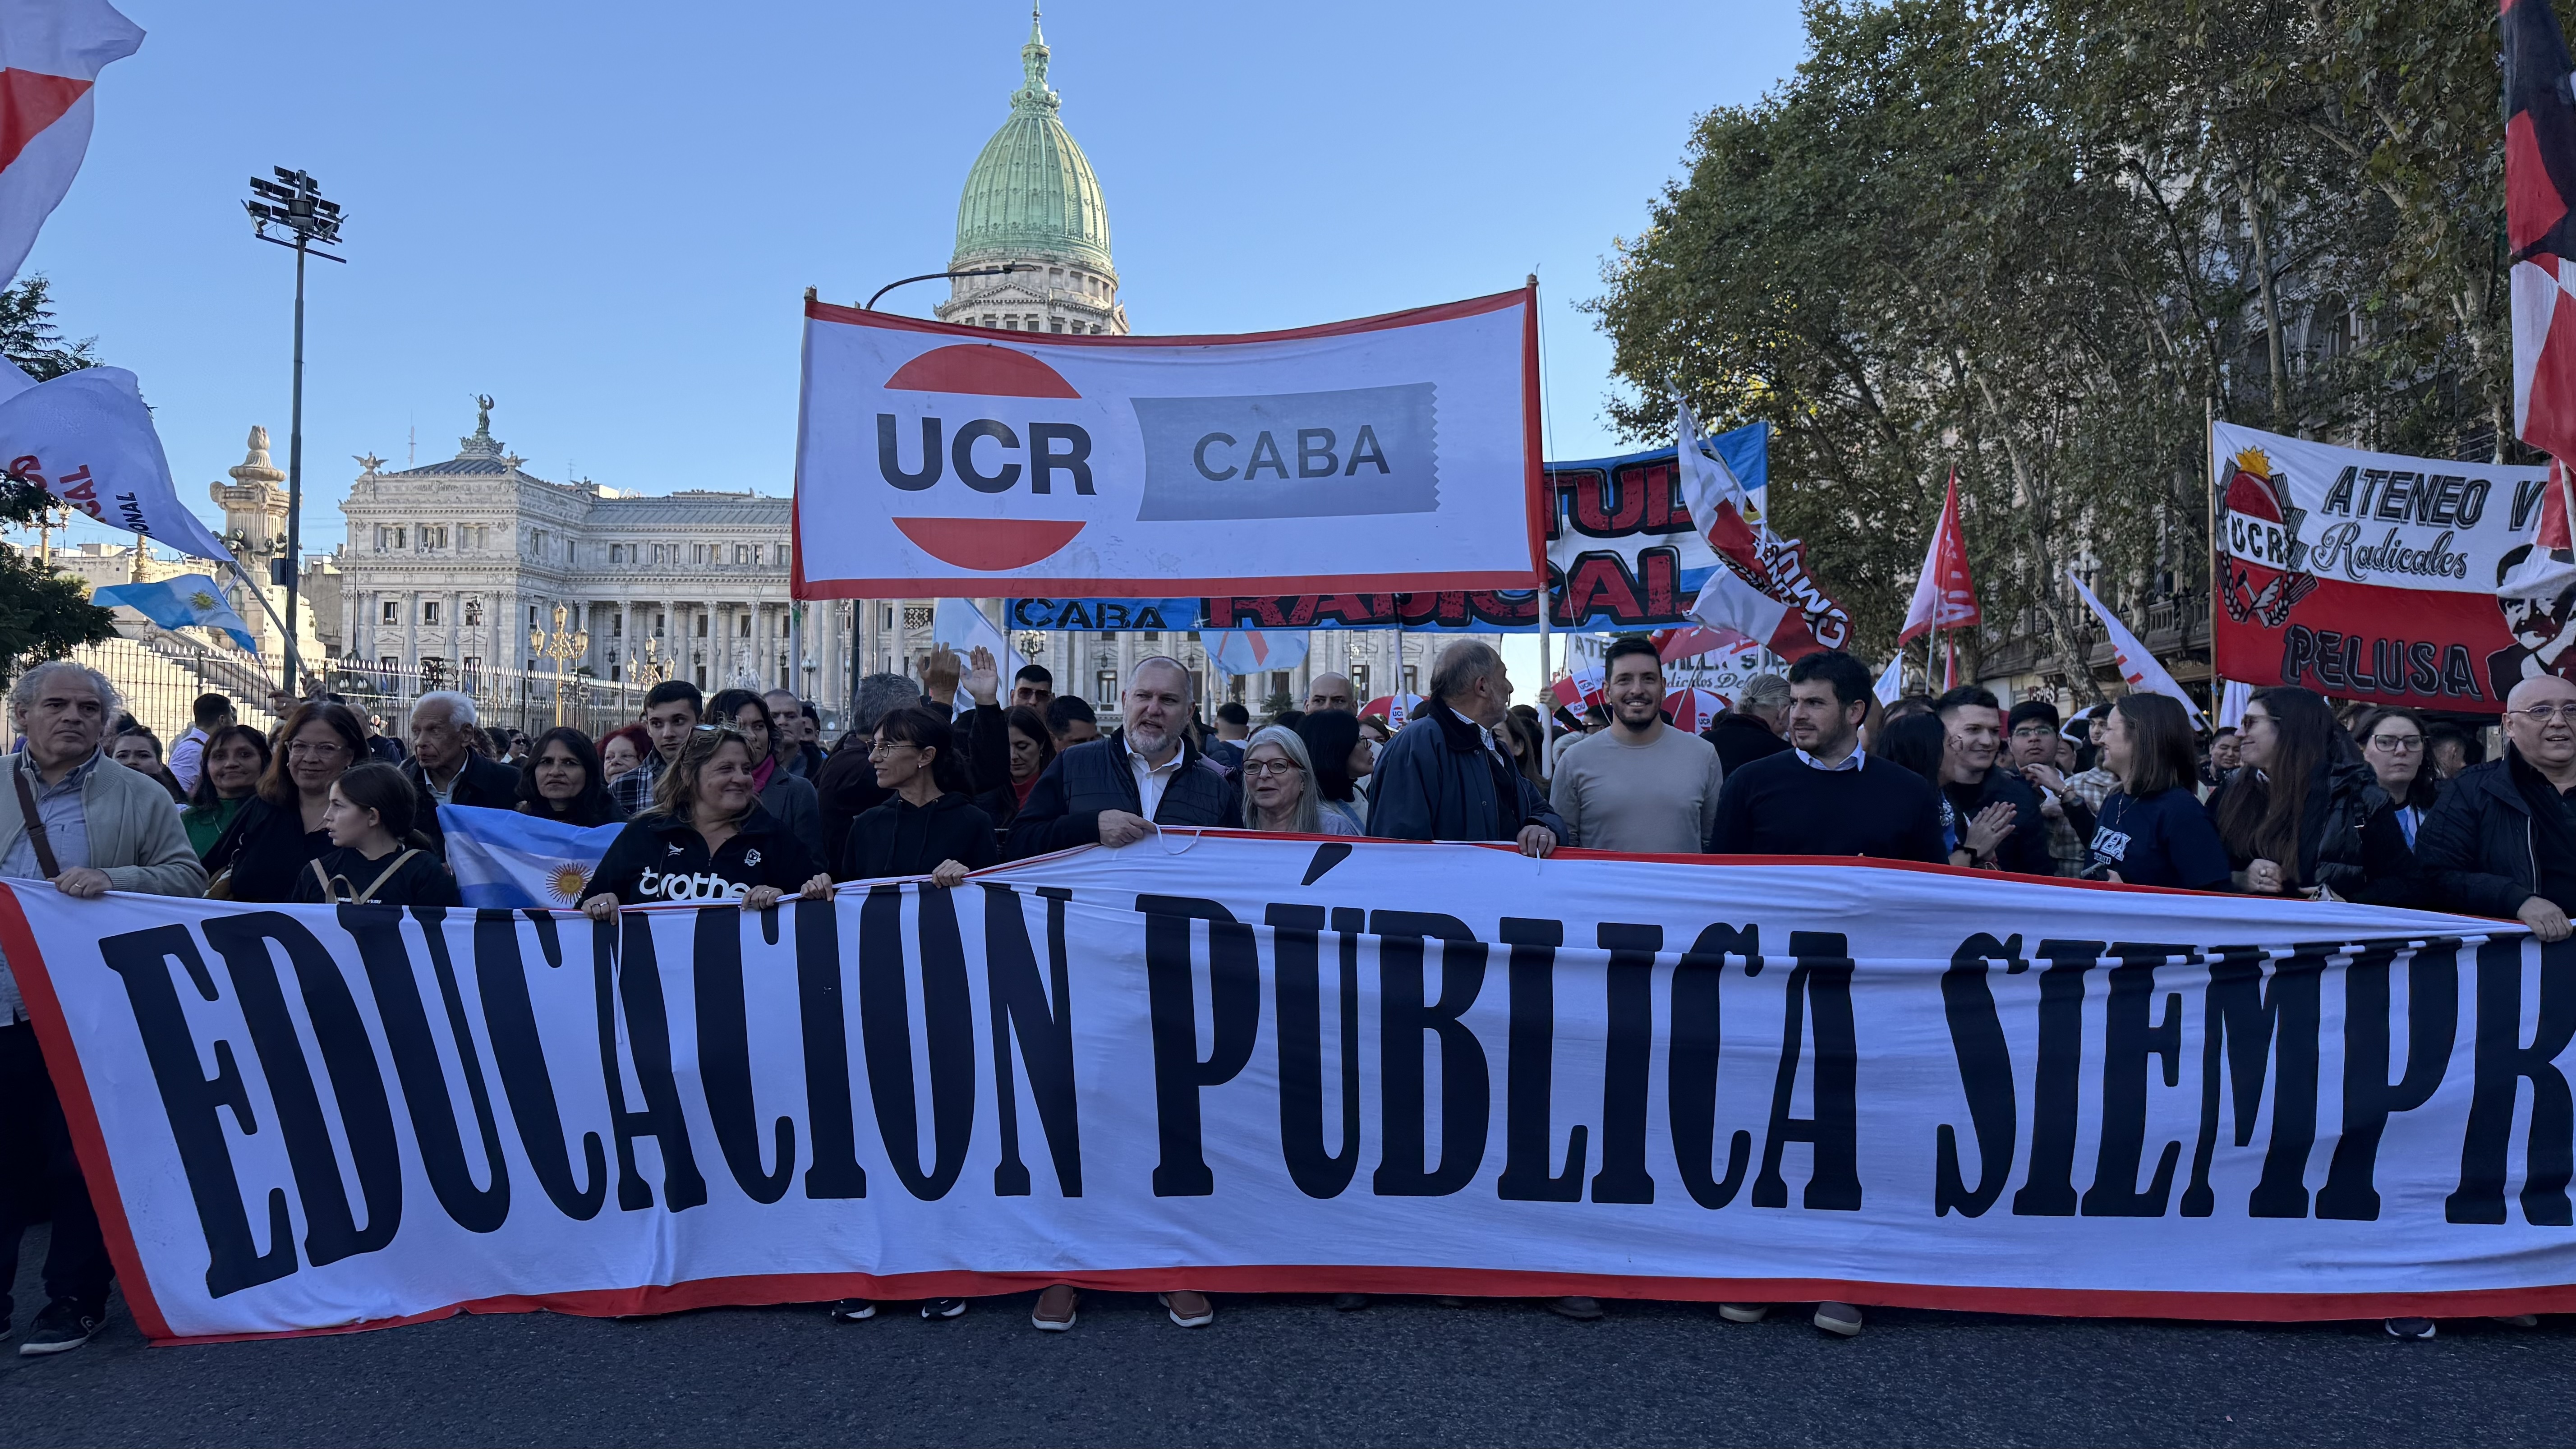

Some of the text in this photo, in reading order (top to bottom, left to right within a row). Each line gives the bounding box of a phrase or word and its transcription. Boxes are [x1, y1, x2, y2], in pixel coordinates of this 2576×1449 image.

[876, 412, 1391, 496] UCR CABA
[2321, 466, 2548, 531] ATENEO V
[2231, 515, 2284, 564] UCR
[2311, 519, 2468, 582] Radicales
[1014, 598, 1168, 629] CABA
[1574, 635, 1610, 658] ATE
[2281, 623, 2483, 702] PELUSA
[2090, 826, 2132, 862] UBA
[639, 866, 751, 900] brothe
[98, 885, 1083, 1300] EDUCACION
[1134, 842, 1863, 1212] PÚBLICA
